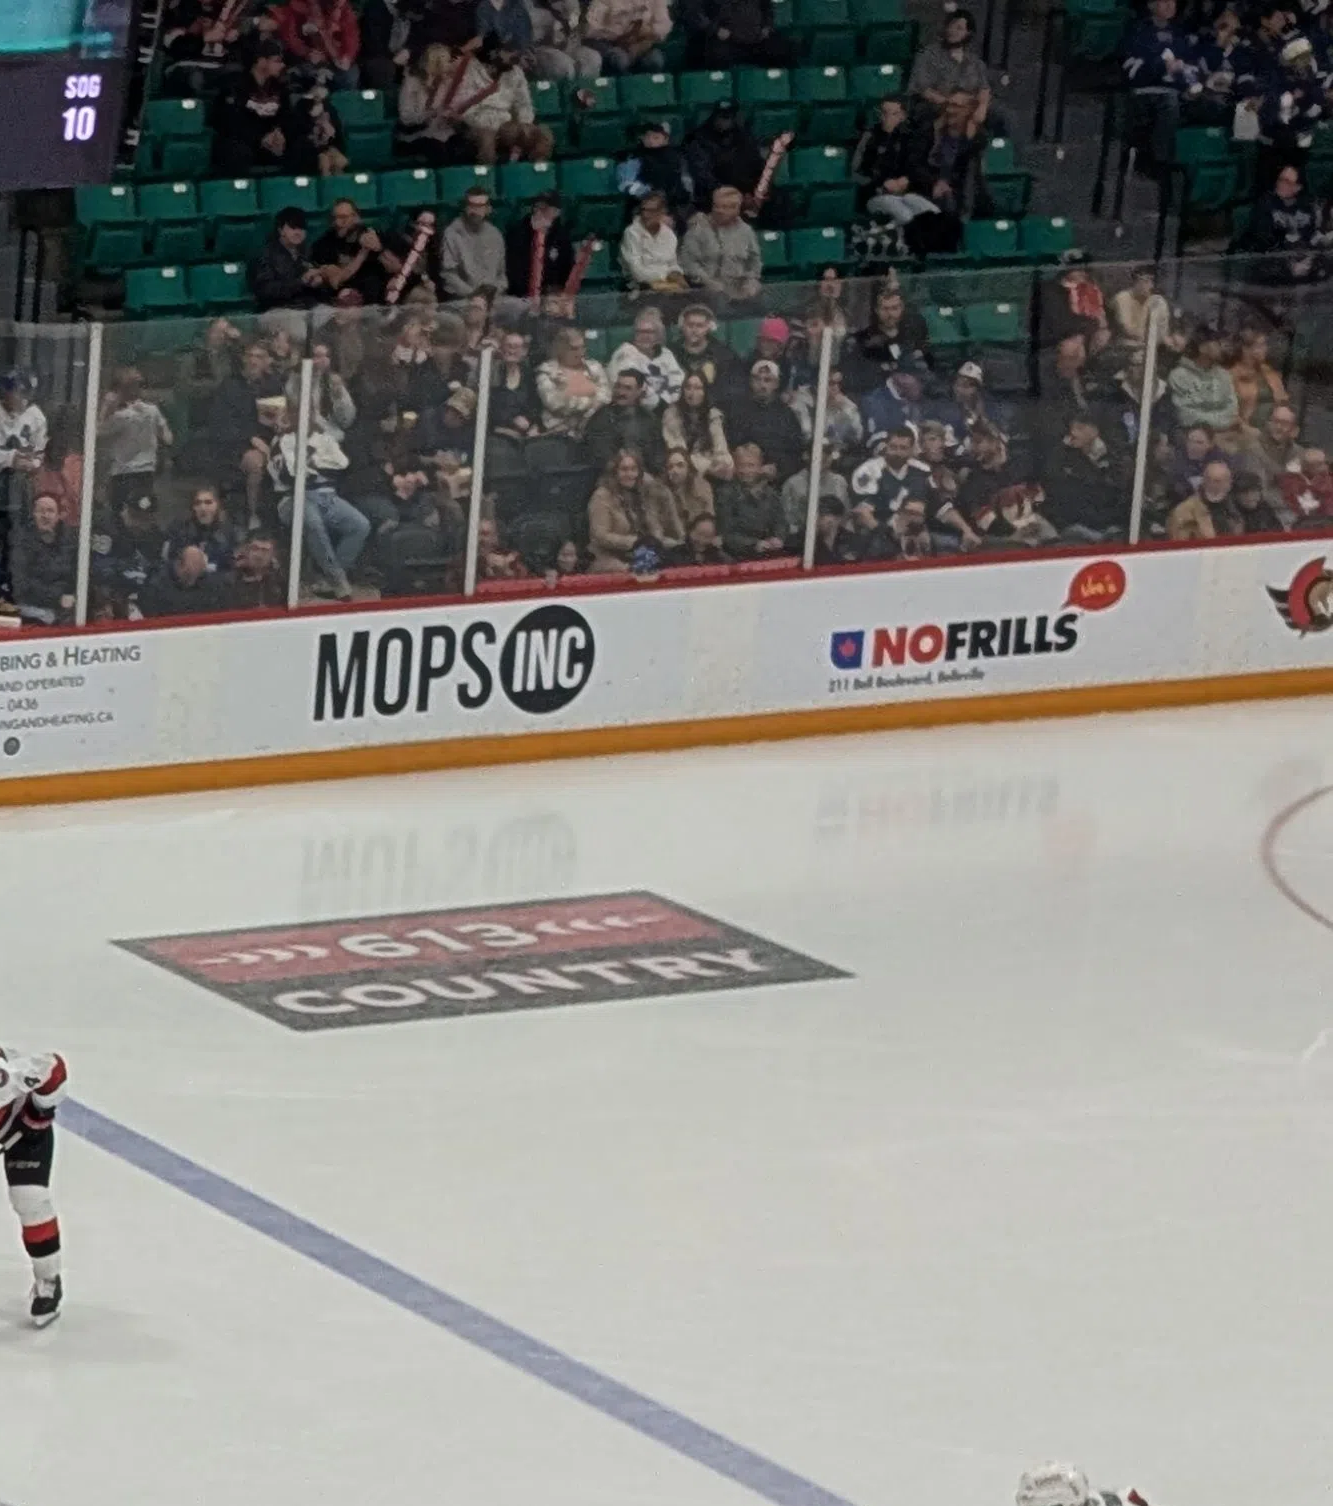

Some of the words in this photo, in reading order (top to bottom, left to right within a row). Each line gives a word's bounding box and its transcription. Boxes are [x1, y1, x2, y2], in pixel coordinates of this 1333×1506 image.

[64, 74, 101, 99] SOG
[61, 107, 95, 141] 10
[46, 652, 57, 668] &
[63, 645, 141, 666] HEATING
[313, 621, 496, 721] MOPS
[512, 626, 585, 692] INC
[338, 922, 539, 960] 613
[271, 946, 777, 1016] COUNTRY
